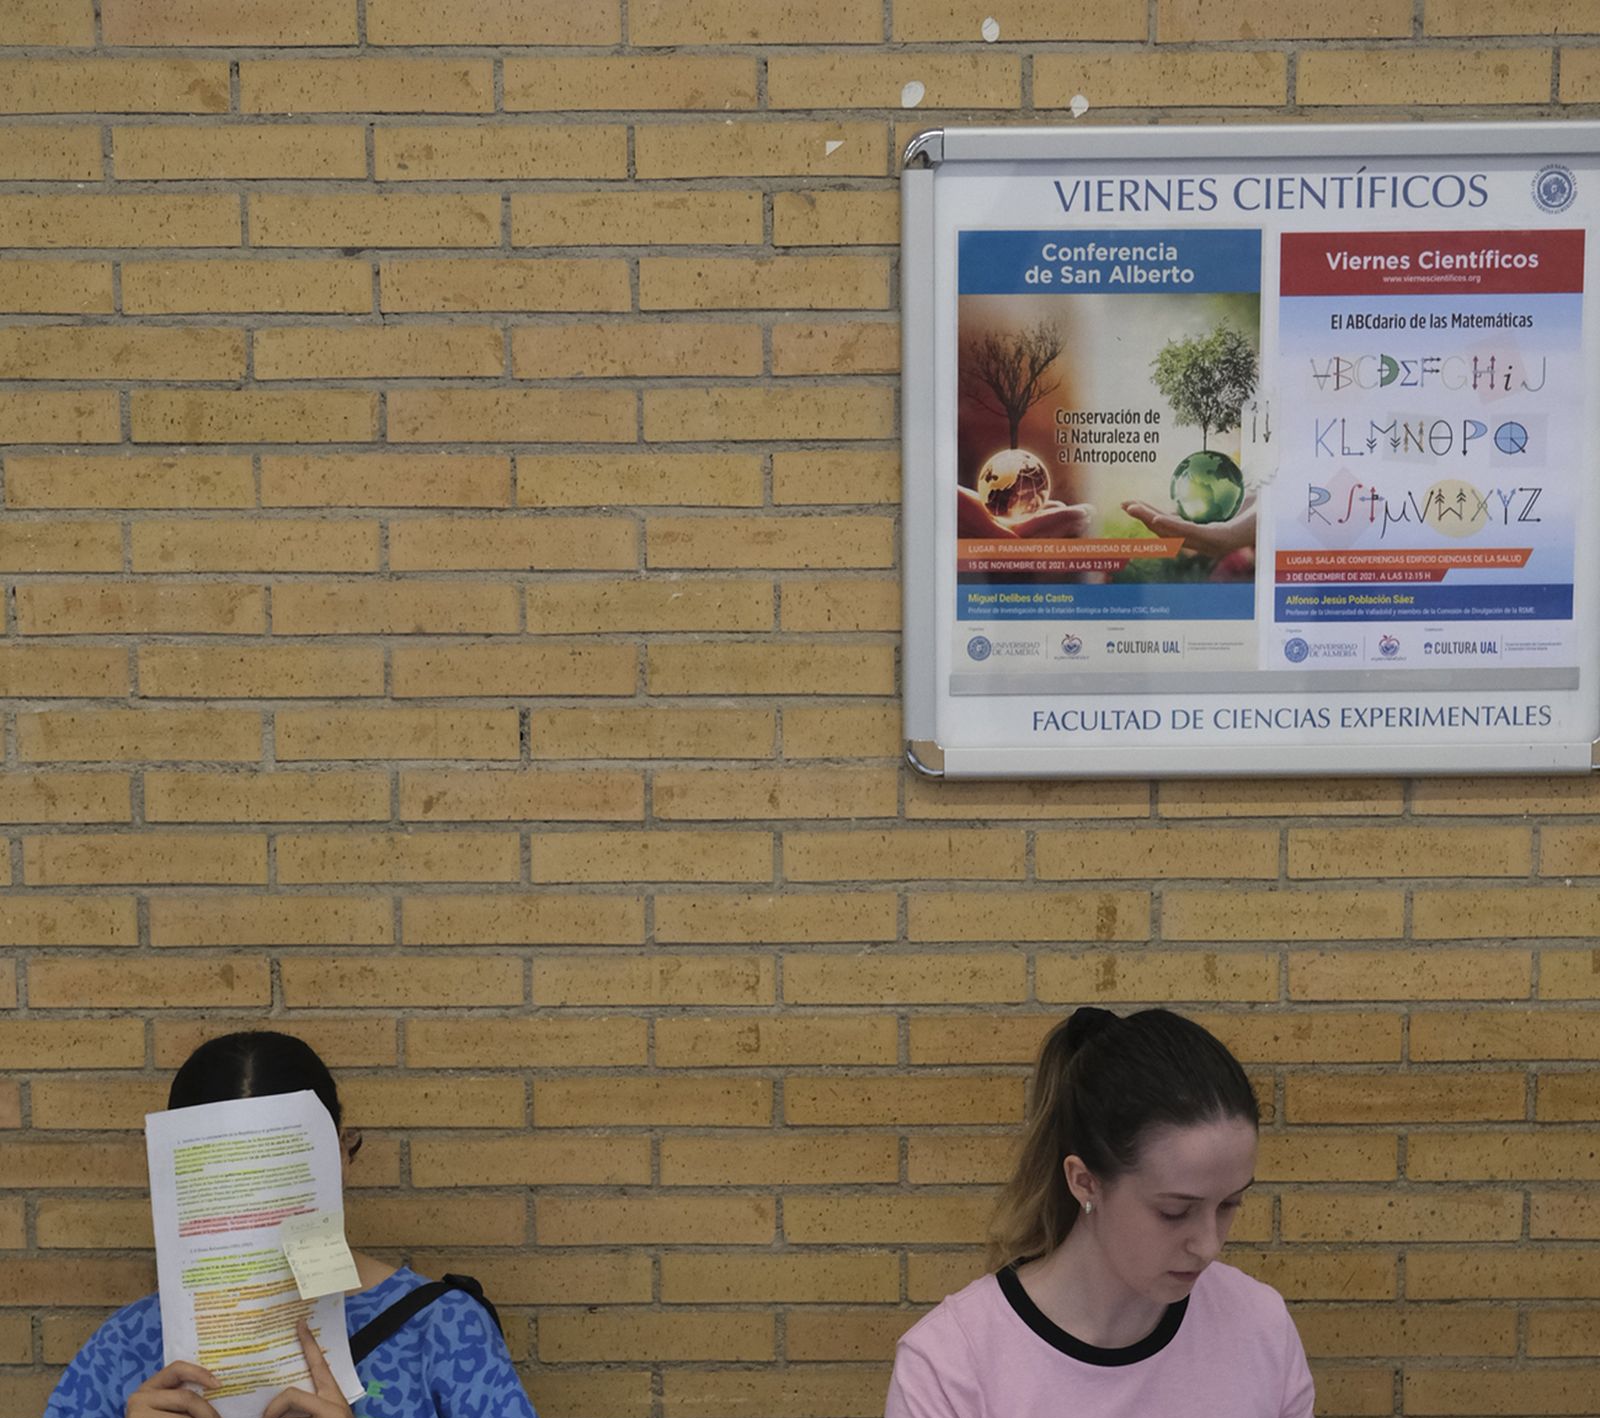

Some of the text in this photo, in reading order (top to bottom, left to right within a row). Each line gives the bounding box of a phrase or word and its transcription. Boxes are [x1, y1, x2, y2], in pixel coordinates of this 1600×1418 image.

[1054, 178, 1218, 212] VIERNES
[1233, 166, 1489, 210] CIENTÍFICOS
[1042, 242, 1178, 261] Conferencia
[1326, 249, 1540, 271] Viernes Científicos
[1025, 264, 1195, 284] de San Alberto
[1331, 311, 1534, 330] El ABCdario de las Matemáticas
[1056, 408, 1161, 425] Conservación de
[1056, 428, 1160, 444] la Naturaleza en
[1059, 447, 1157, 465] el Antropoceno
[1044, 545, 1054, 553] DE
[1056, 545, 1067, 553] LA
[1068, 544, 1120, 553] UNIVERSIDAD
[1121, 544, 1131, 552] DE
[968, 561, 977, 569] 15
[978, 561, 989, 569] DE
[991, 561, 1035, 569] NOVIEMBRE
[1037, 561, 1047, 569] DE
[1069, 561, 1075, 569] A
[1076, 561, 1091, 569] LAS
[1114, 561, 1120, 569] H
[1315, 556, 1336, 565] SALA
[1336, 556, 1346, 564] DE
[1348, 555, 1405, 564] CONFERENCIAS
[1406, 555, 1436, 564] EDIFICIO
[1438, 555, 1472, 563] CIENCIAS
[1473, 555, 1483, 563] DE
[1484, 555, 1495, 563] LA
[1496, 554, 1522, 563] SALUD
[1286, 573, 1291, 581] 3
[1292, 572, 1303, 581] DE
[1304, 572, 1345, 581] DICIEMBRE
[1347, 572, 1358, 580] DE
[1379, 572, 1386, 580] A
[1387, 572, 1403, 580] LAS
[1425, 571, 1431, 580] H
[968, 593, 1074, 605] Miguel Delibes de Castro
[1286, 594, 1414, 605] Alfonso Jesús Población Sáez
[1116, 640, 1160, 654] CULTURA
[1162, 640, 1180, 654] UAL
[1434, 641, 1477, 655] CULTURA
[1480, 640, 1498, 654] UAL
[1033, 704, 1553, 732] FACULTAD DE CIENCIAS EXPERIMENTALES
